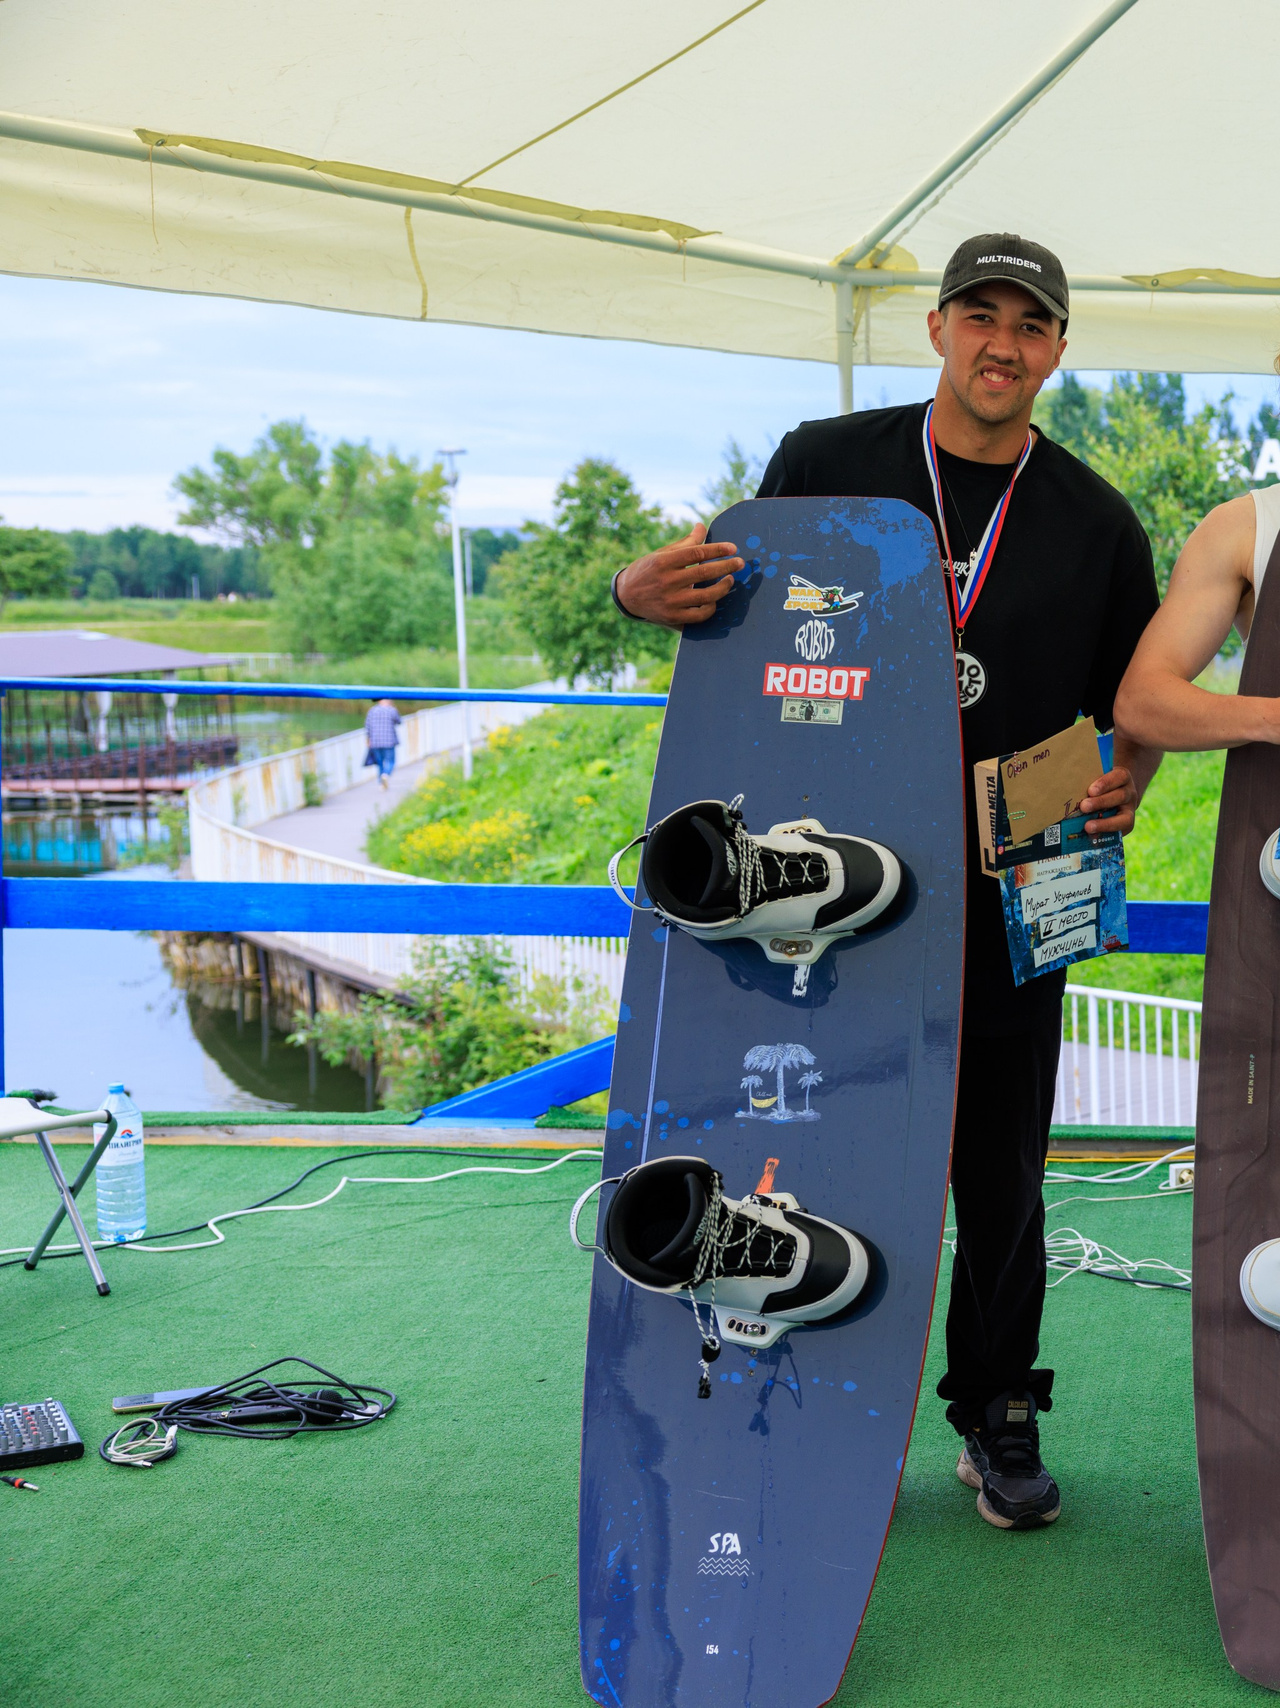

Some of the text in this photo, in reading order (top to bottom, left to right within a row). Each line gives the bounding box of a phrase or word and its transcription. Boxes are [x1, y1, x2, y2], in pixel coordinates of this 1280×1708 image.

[976, 254, 1042, 273] MULTIRIDERS
[785, 600, 825, 610] SPORT
[794, 619, 836, 662] ROBOT
[765, 665, 868, 697] ROBOT
[1033, 748, 1051, 764] men
[986, 775, 997, 811] MELTA
[1036, 865, 1072, 877] НАГРАЖДАЕТСЯ
[1025, 897, 1050, 918] Мурат
[708, 1532, 742, 1556] SPA
[705, 1644, 720, 1655] 154
